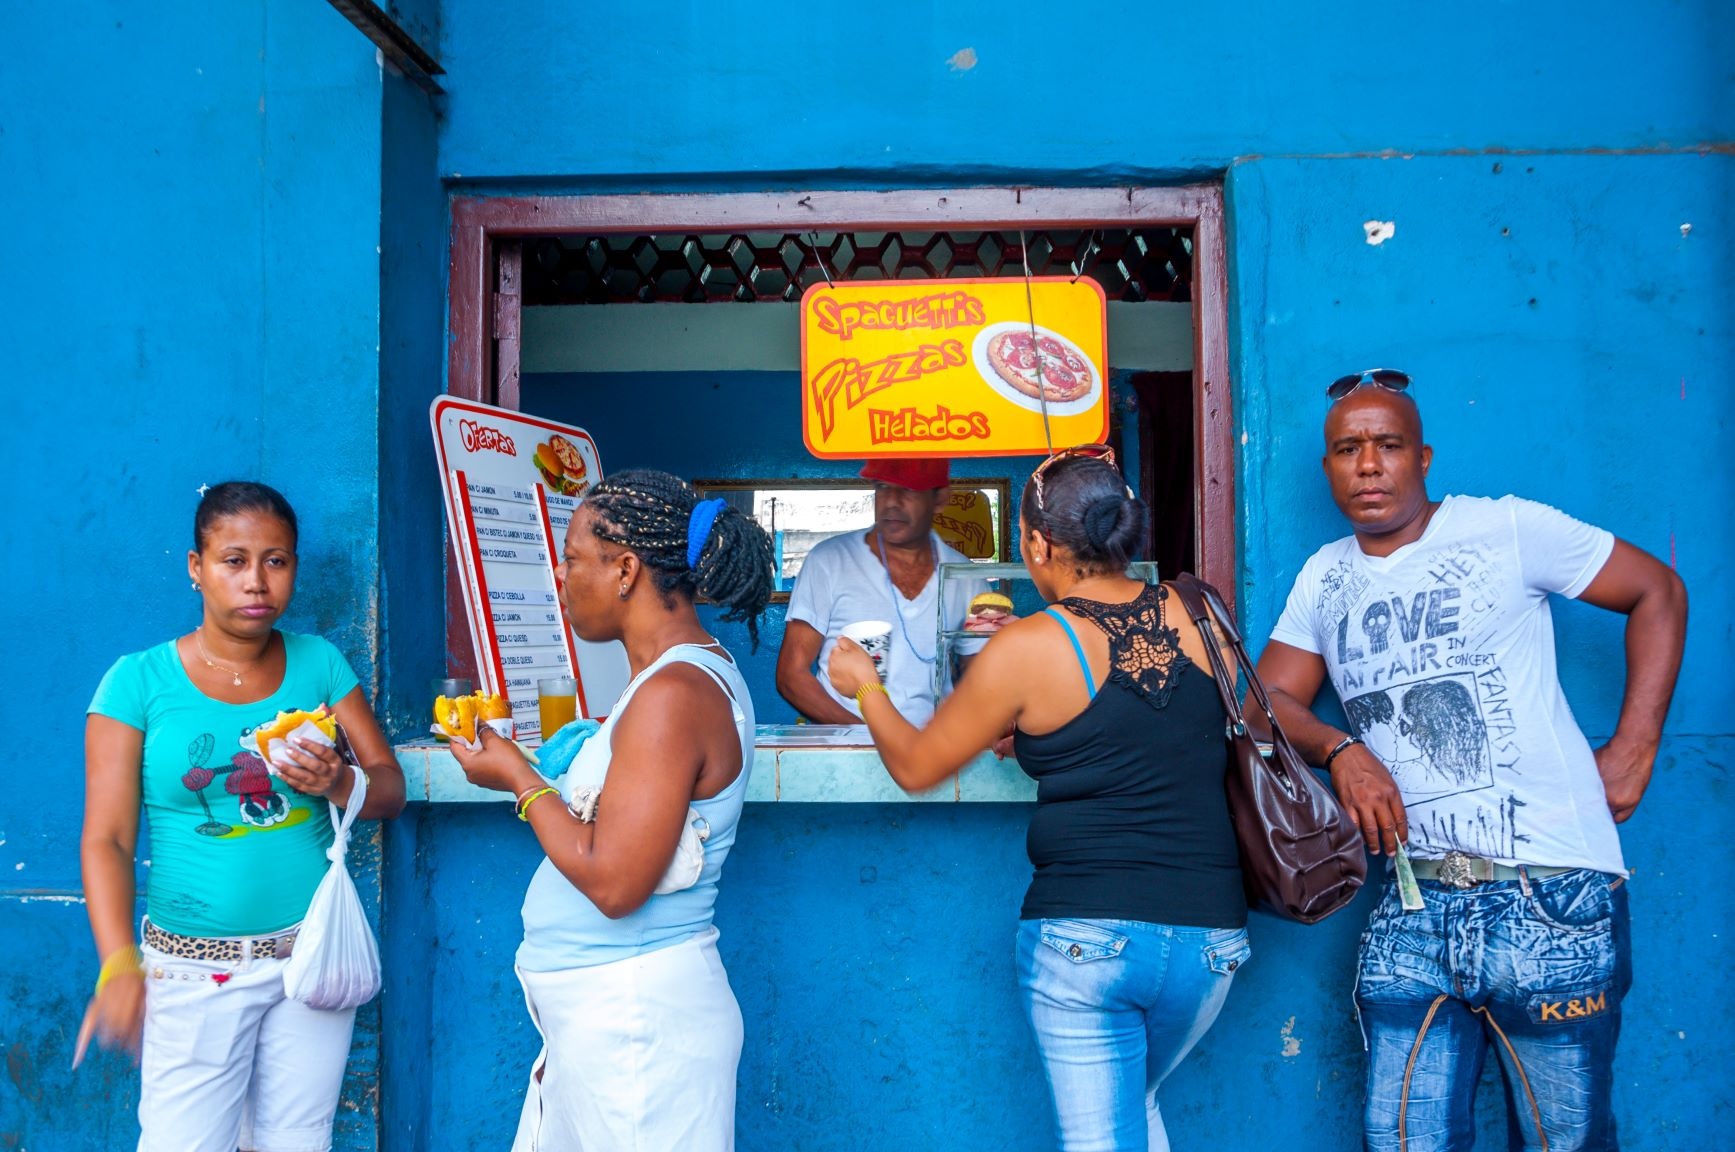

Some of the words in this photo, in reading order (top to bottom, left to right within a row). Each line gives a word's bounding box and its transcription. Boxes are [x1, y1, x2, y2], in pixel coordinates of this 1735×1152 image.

[811, 338, 967, 444] Pizzas
[868, 404, 991, 445] Helados
[1446, 652, 1497, 668] CONCERT
[1447, 635, 1467, 650] IN
[1477, 666, 1523, 776] FANTASY
[1541, 991, 1606, 1021] K&M
